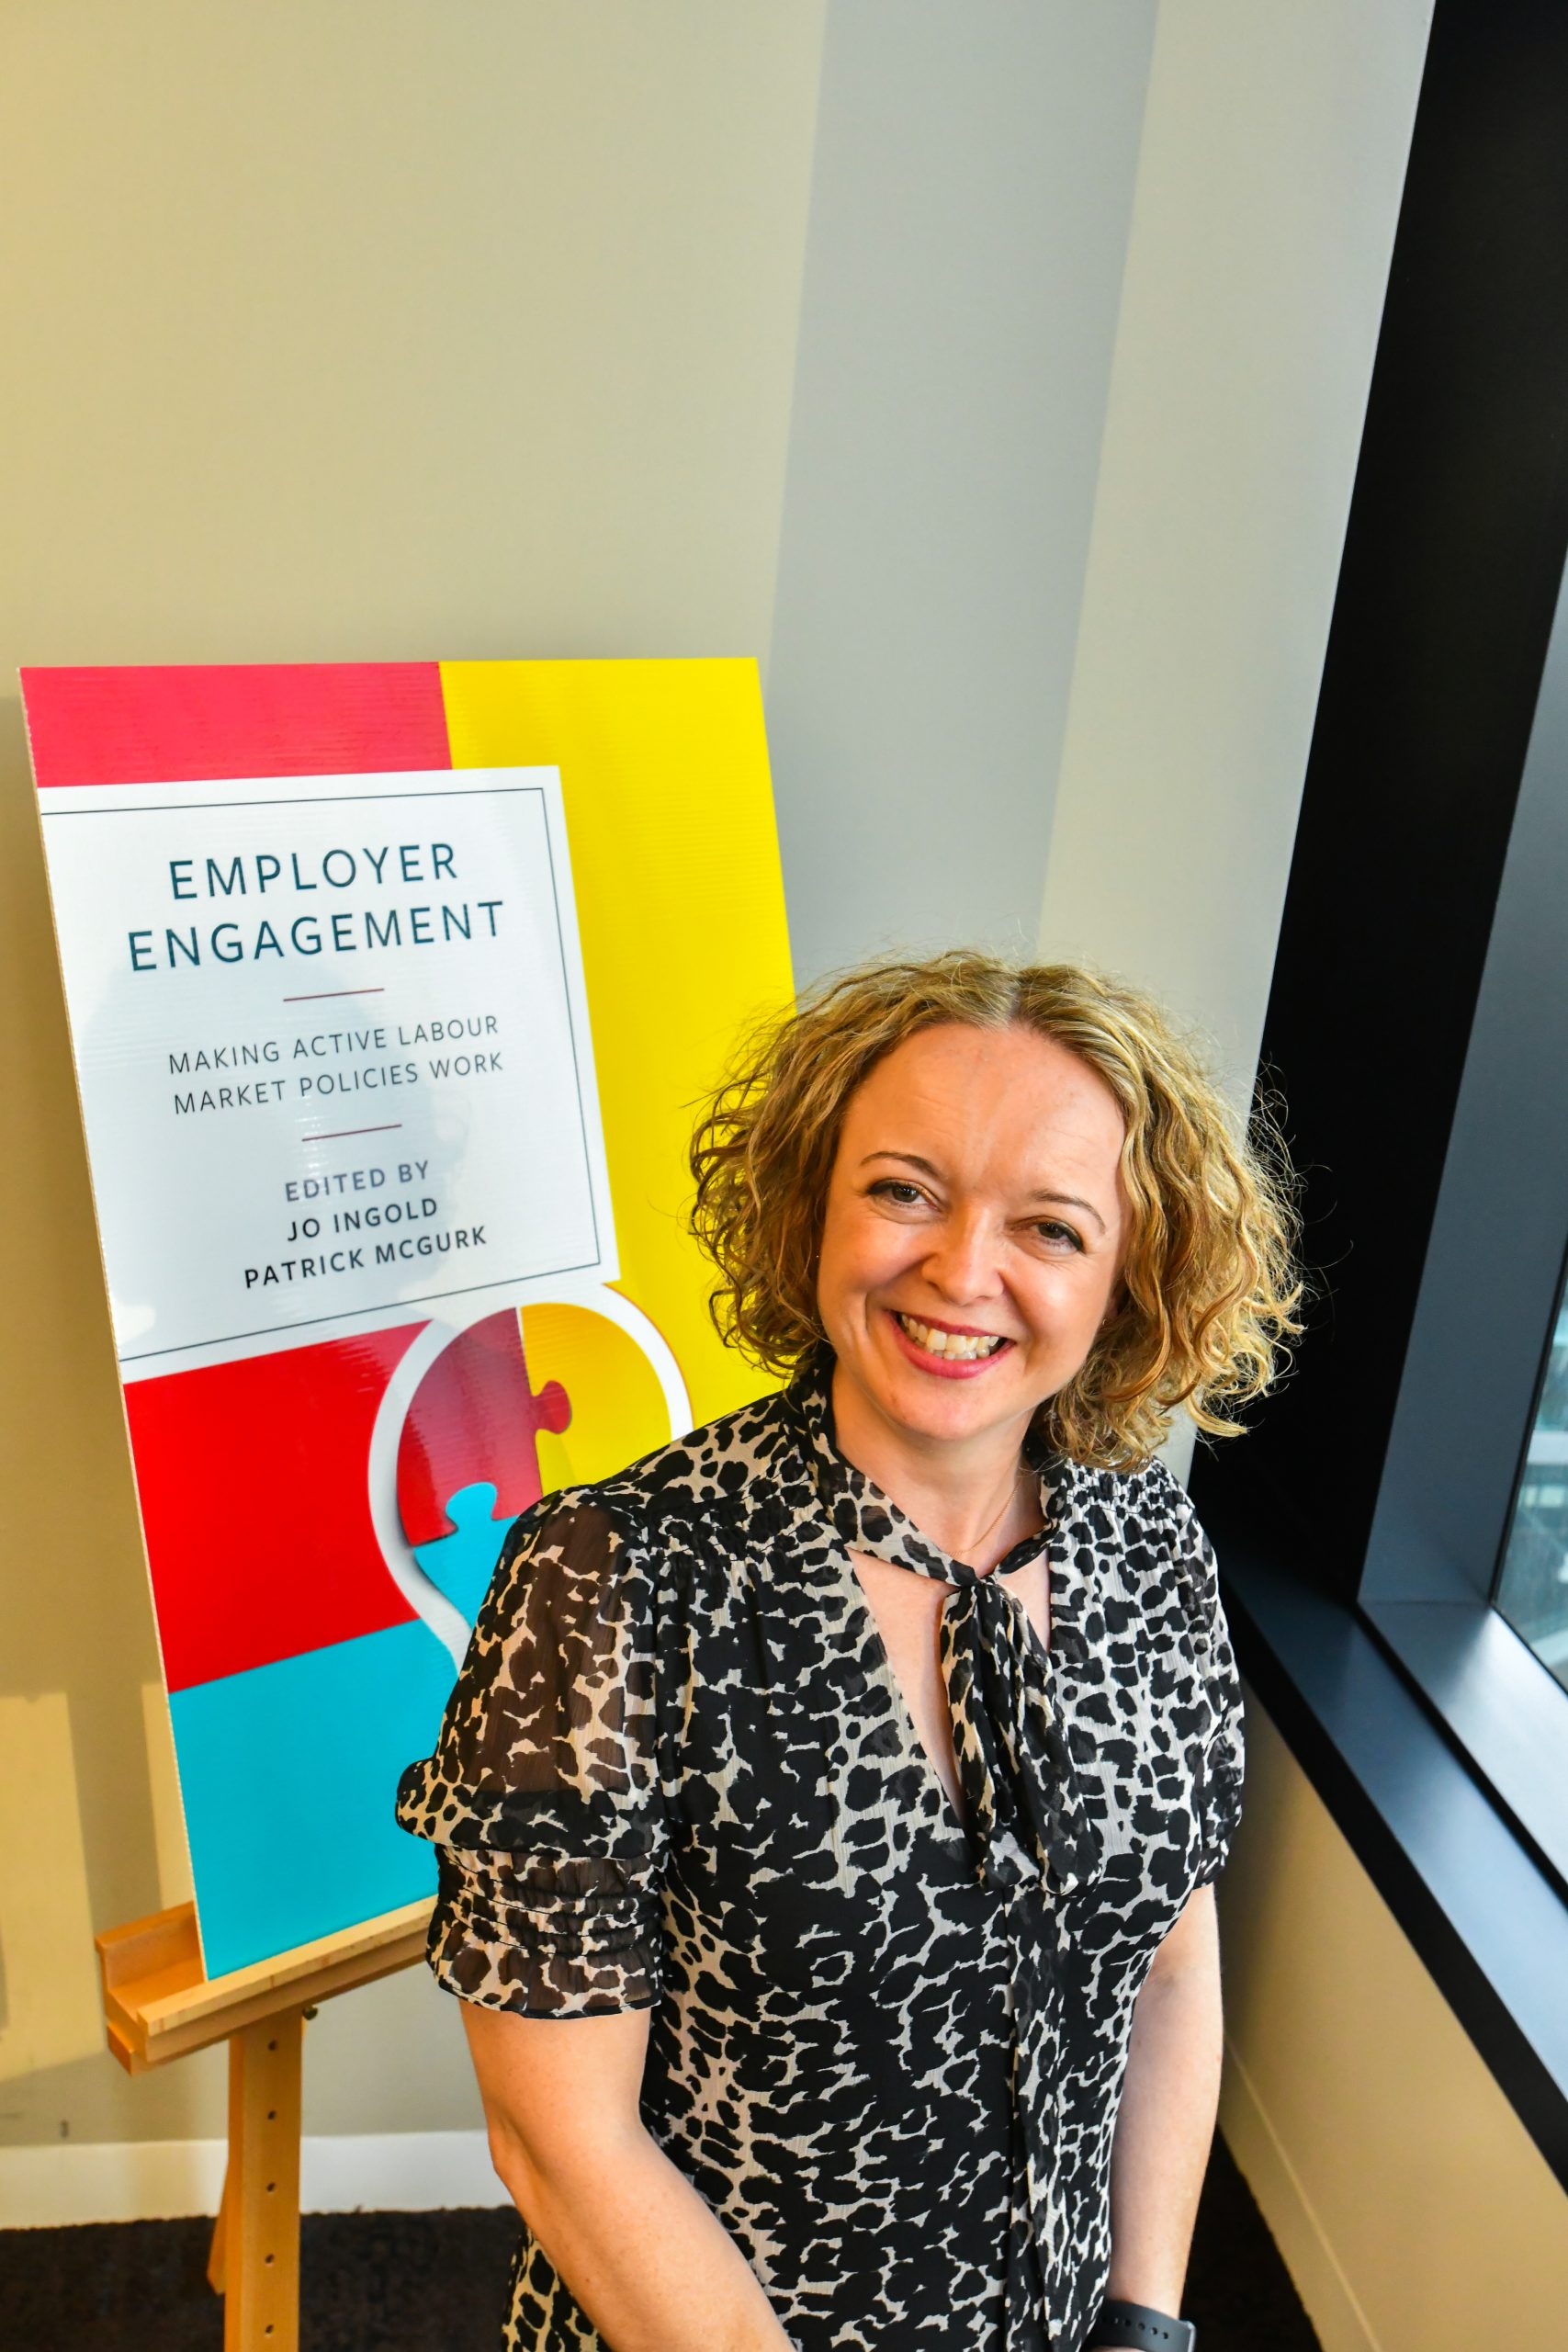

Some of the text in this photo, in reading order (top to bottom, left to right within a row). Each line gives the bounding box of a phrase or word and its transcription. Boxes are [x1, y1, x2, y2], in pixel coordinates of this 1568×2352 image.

[168, 842, 459, 900] EMPLOYER
[127, 900, 504, 972] ENGAGEMENT
[168, 1015, 499, 1075] MAKING ACTIVE LABOUR
[174, 1052, 504, 1115] MARKET POLICIES WORK
[284, 1159, 431, 1203] EDITED BY
[287, 1197, 438, 1242] JO INGOLD
[244, 1226, 488, 1289] PATRICK MCGURK
